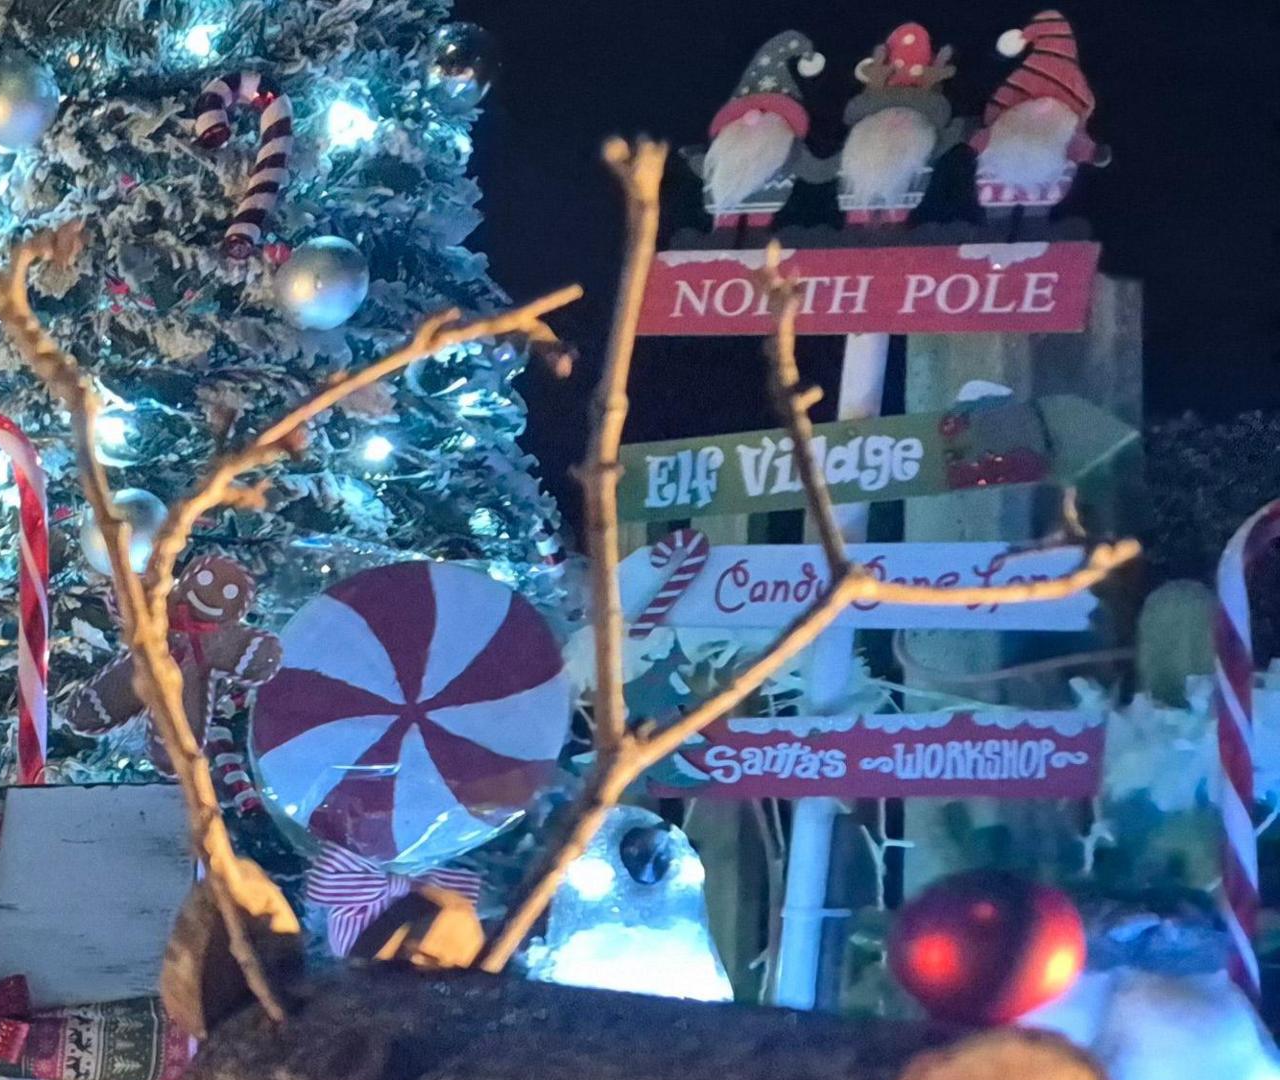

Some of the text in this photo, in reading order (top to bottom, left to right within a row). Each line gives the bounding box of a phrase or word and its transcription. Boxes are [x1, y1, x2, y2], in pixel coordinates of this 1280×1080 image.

[670, 272, 1060, 318] NOTH POLE
[644, 445, 724, 509] Elf
[892, 739, 1056, 780] WORKSHOP
